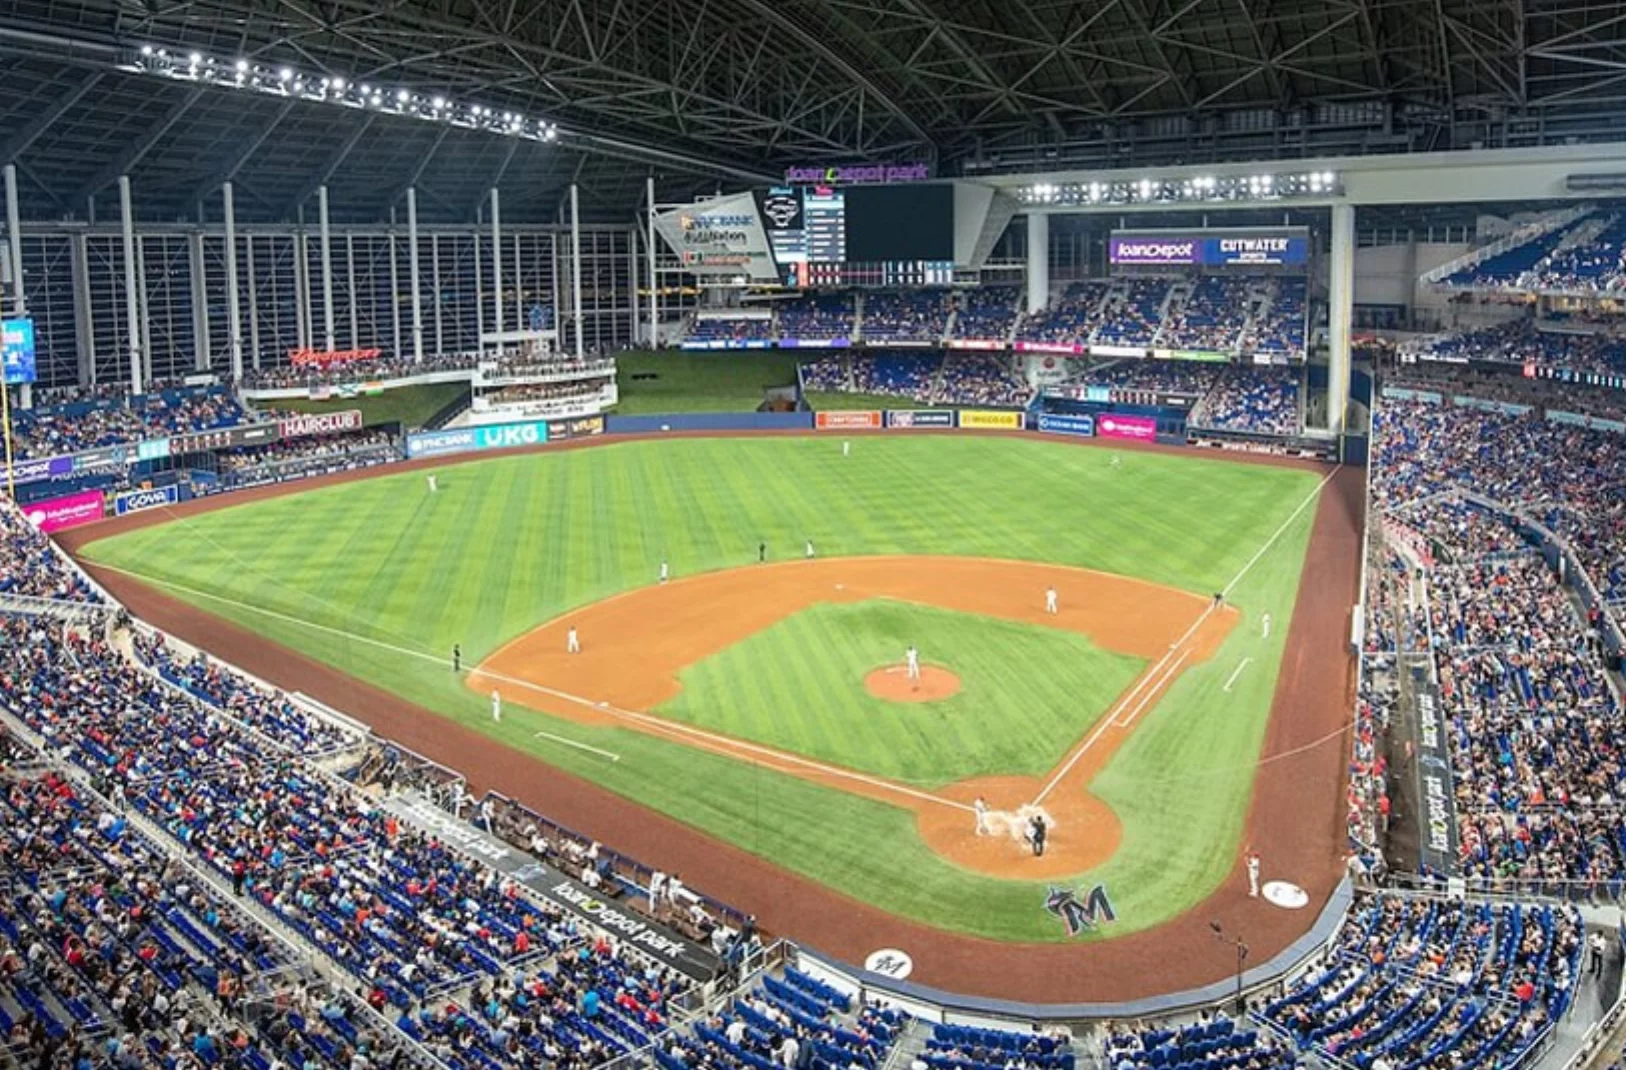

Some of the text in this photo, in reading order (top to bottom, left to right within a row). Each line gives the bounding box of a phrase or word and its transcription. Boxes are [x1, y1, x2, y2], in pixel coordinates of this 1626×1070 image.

[887, 163, 929, 183] park
[1118, 242, 1193, 259] loanDepot
[1220, 238, 1289, 253] CUTWATER
[285, 413, 355, 436] HAIRCLUB
[483, 423, 539, 447] UKG
[551, 881, 686, 958] loanDepot park
